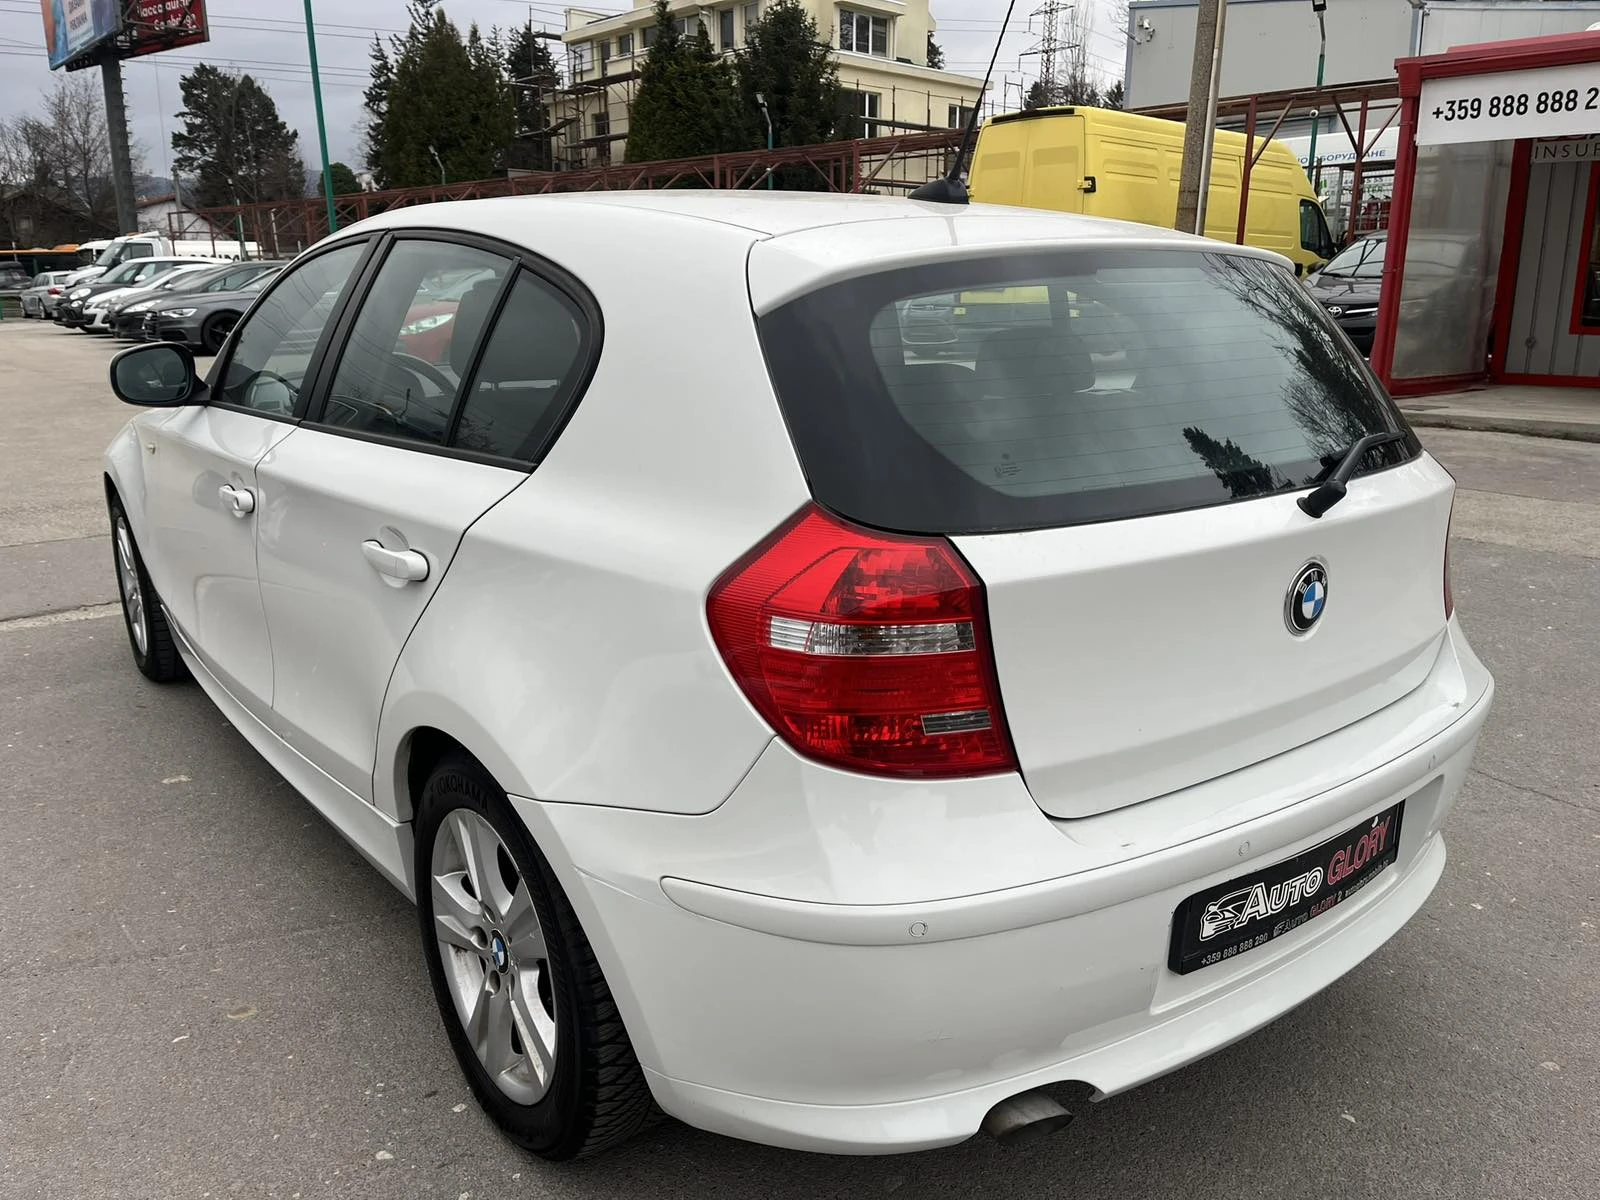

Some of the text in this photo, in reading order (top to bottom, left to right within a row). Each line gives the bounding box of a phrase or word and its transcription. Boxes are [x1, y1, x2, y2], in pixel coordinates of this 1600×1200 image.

[1432, 98, 1482, 121] +359
[1488, 94, 1529, 117] 888
[1536, 89, 1579, 114] 888
[1327, 815, 1391, 885] GLORY
[1201, 932, 1268, 965] +359 888 888 290
